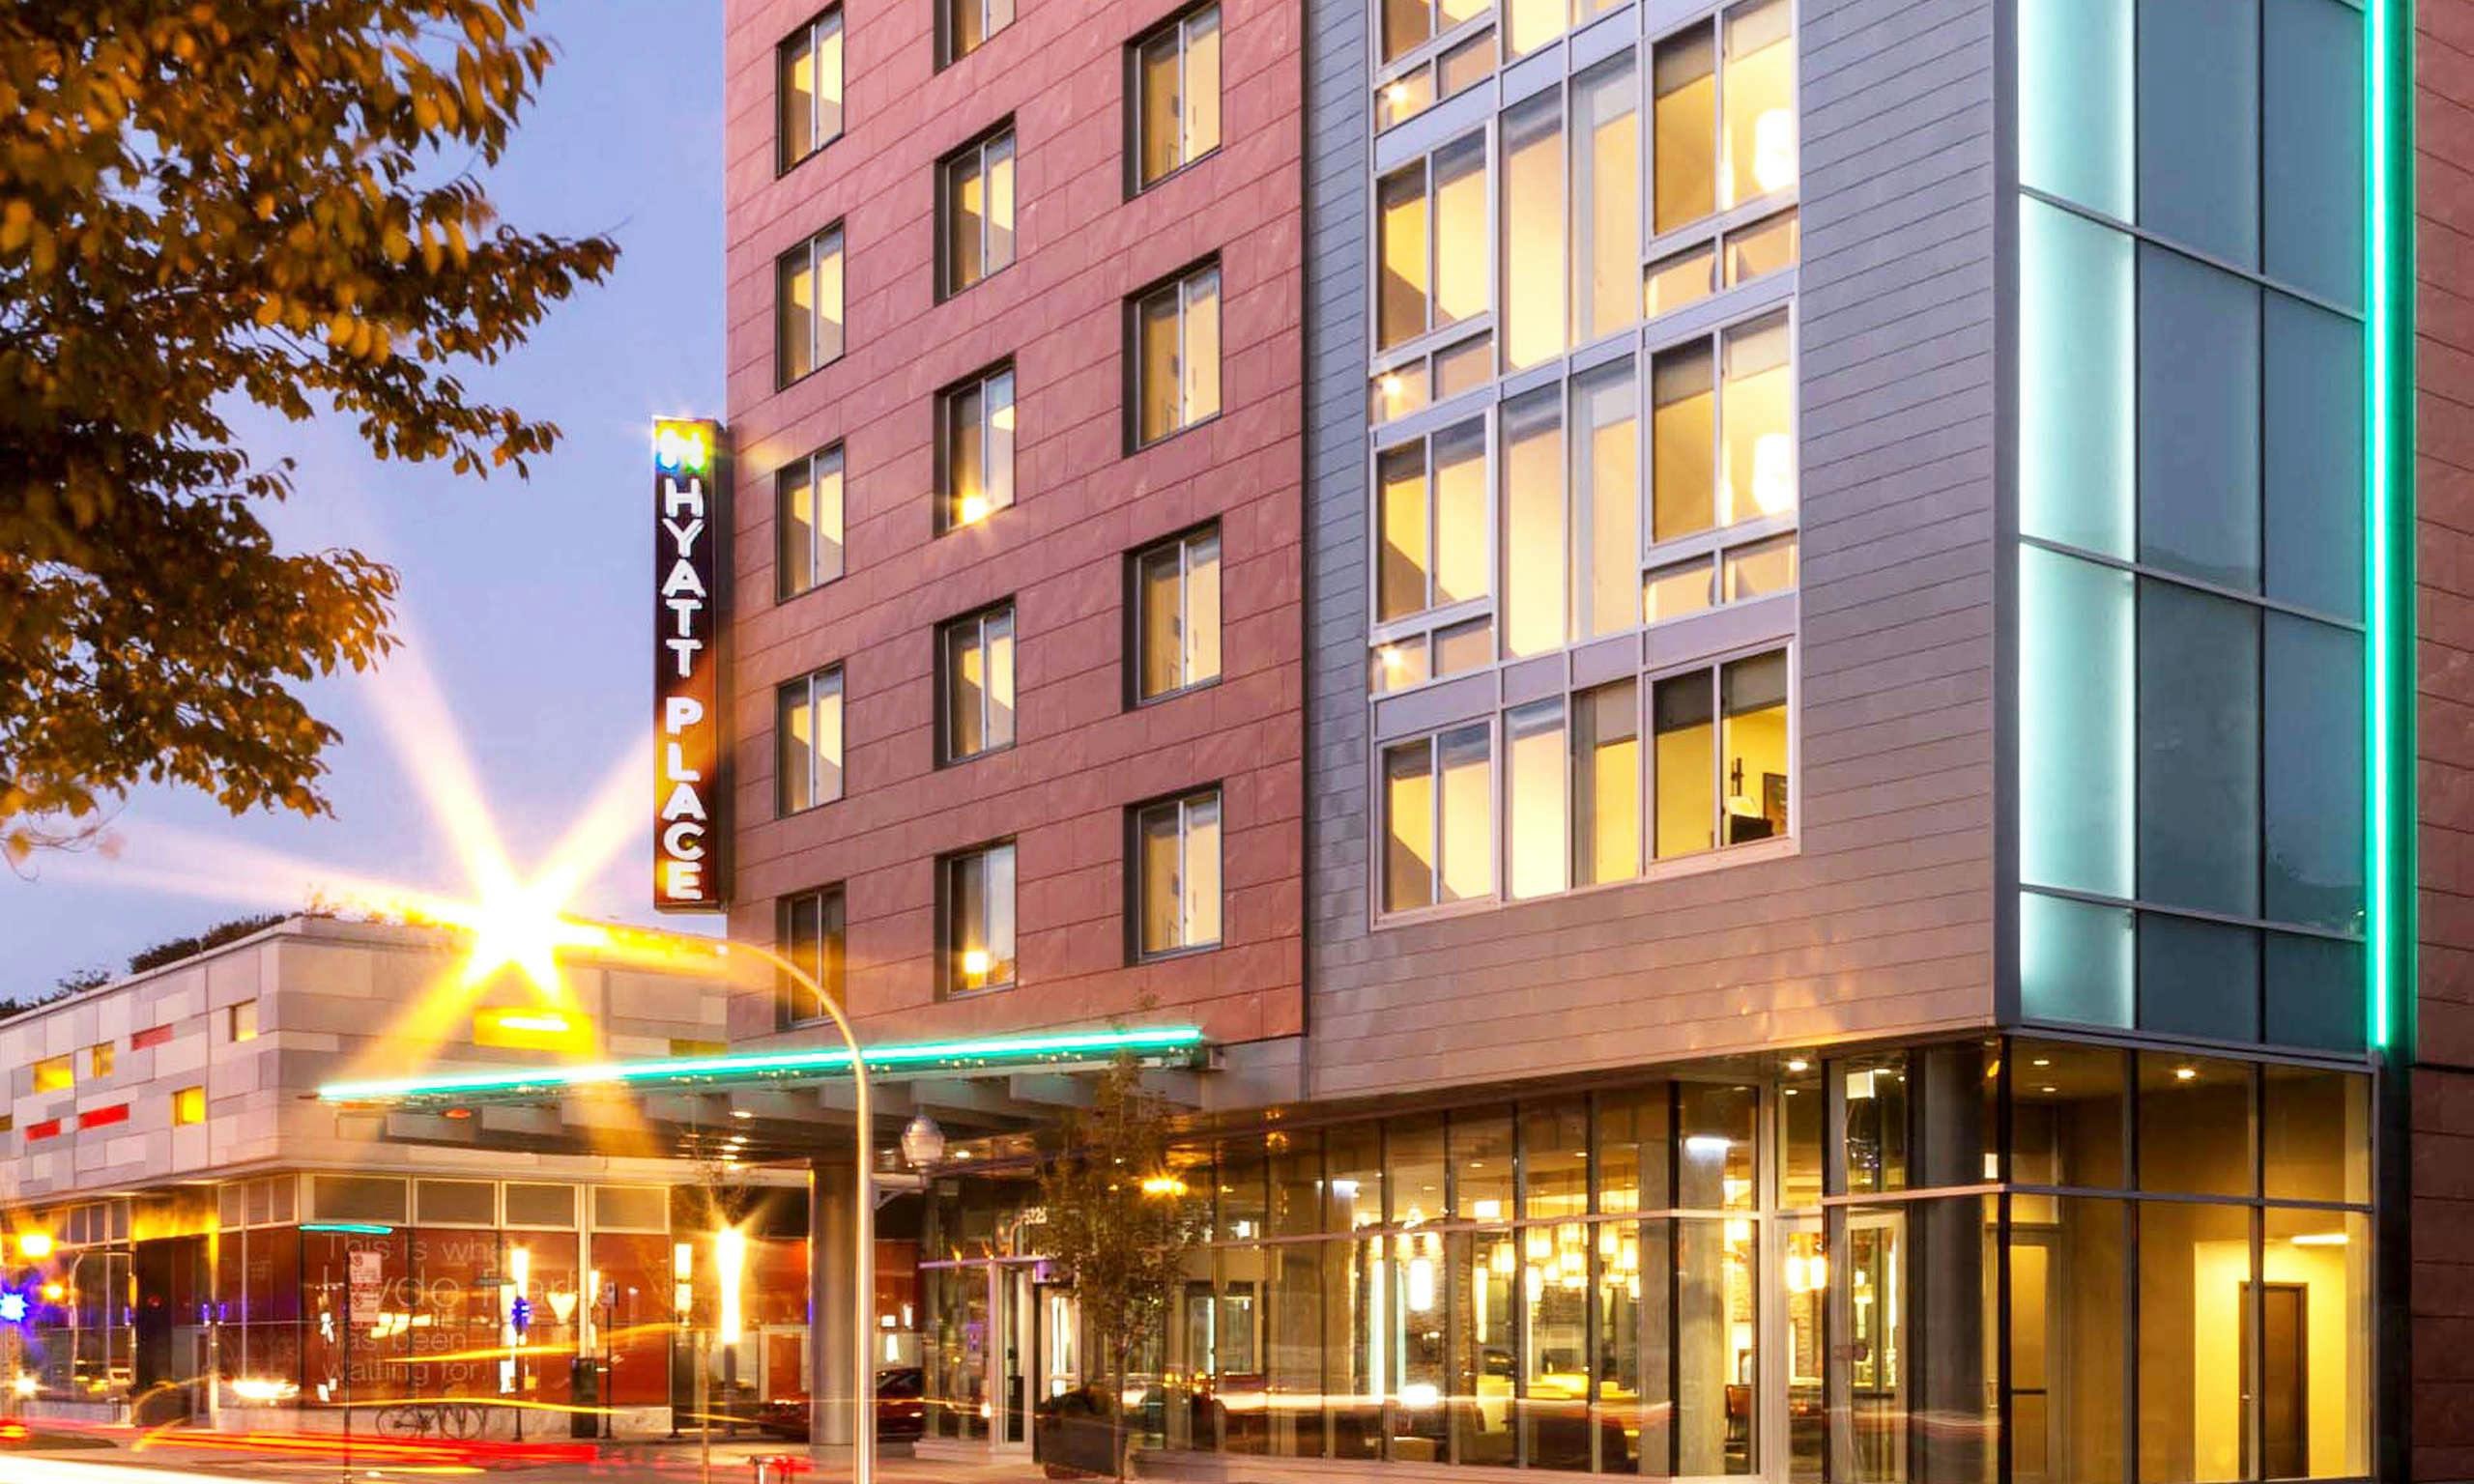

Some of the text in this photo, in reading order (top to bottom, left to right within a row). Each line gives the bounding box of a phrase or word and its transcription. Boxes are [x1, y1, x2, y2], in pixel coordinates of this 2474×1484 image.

[661, 477, 707, 899] HYATT PLACE
[322, 1232, 390, 1260] This
[323, 1356, 430, 1386] waiting
